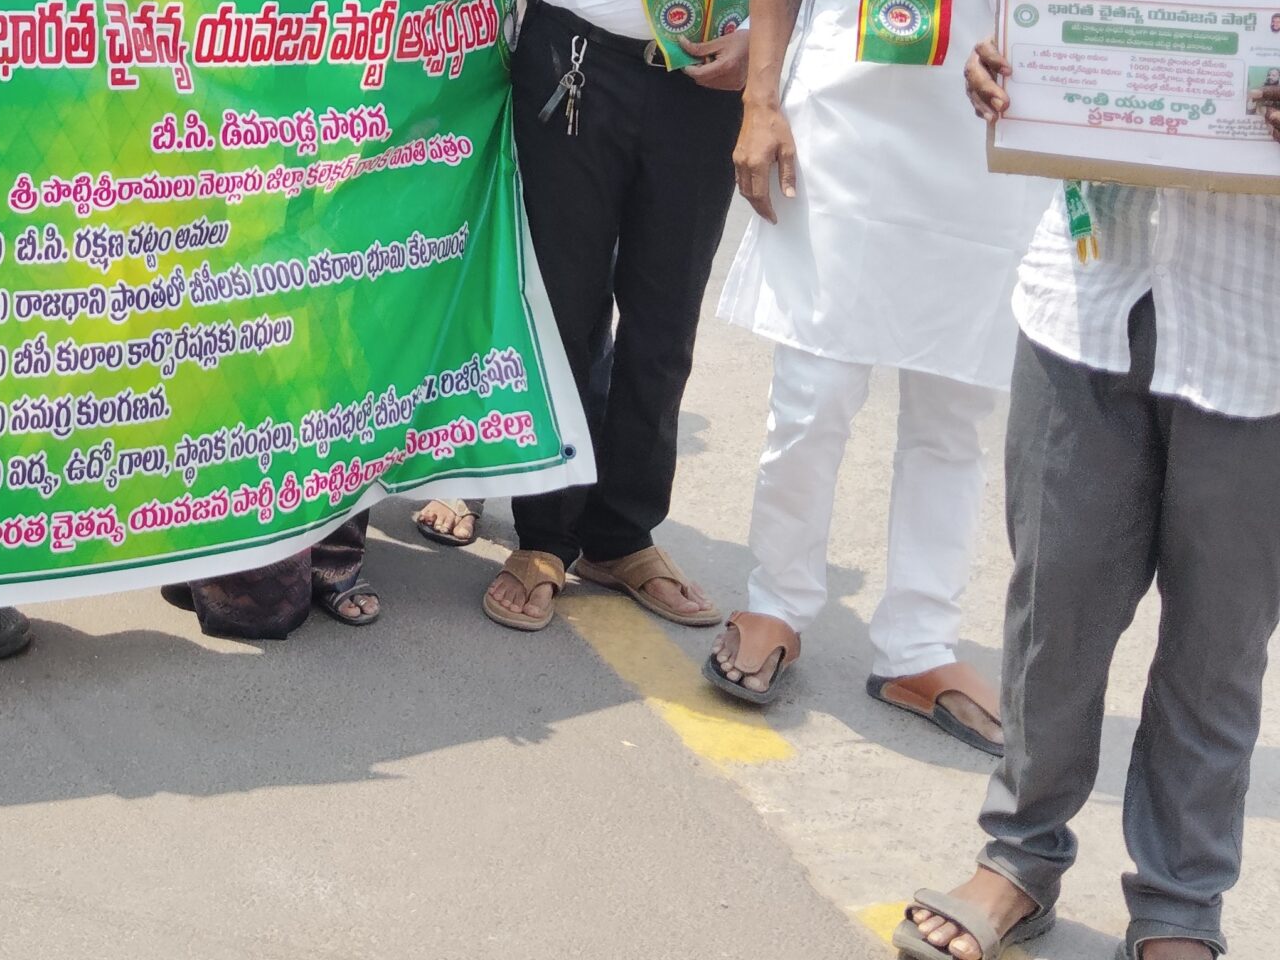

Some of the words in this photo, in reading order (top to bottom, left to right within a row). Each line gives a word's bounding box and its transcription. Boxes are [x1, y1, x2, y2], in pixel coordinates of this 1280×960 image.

[1048, 2, 1094, 17] భారత
[1098, 4, 1145, 25] చైతన్య
[1148, 7, 1217, 25] యువజన
[1221, 11, 1257, 31] పార్టీ
[104, 2, 192, 90] చైతన్య
[194, 3, 328, 64] యువజన
[329, 0, 398, 87] పార్టీ
[152, 113, 214, 150] బీ.సి.
[221, 110, 317, 153] డిమాండ్ల
[321, 105, 392, 142] సాధన,
[1063, 91, 1109, 107] శాంతి
[1115, 94, 1165, 111] యుత
[1171, 98, 1216, 120] ర్యాలీ
[1088, 108, 1144, 126] ప్రకాశం
[1149, 114, 1188, 135] జిల్లా
[10, 176, 38, 210] శ్రీ
[199, 168, 263, 202] నెల్లూరు
[266, 168, 305, 194] జిల్లా
[429, 134, 472, 163] పత్రం
[17, 226, 68, 262] బీ.సి.
[75, 229, 124, 270] రక్షణ
[128, 226, 171, 269] చట్టం
[174, 219, 229, 250] అమలు
[15, 289, 106, 321] రాజధాని
[189, 264, 252, 304] బీసీలకు
[253, 262, 305, 293] 1000
[308, 250, 364, 284] ఎకరాల
[366, 242, 405, 279] భూమి
[14, 336, 51, 376] బీసీ
[56, 341, 122, 373] కులాల
[239, 317, 293, 354] నిధులు
[9, 454, 59, 495] విద్య,
[66, 441, 170, 489] ఉద్యోగాలు,
[175, 430, 227, 485] స్థానిక
[230, 417, 297, 471] సంస్థలు,
[301, 392, 373, 455] చట్టసభల్లో
[11, 397, 72, 436] సమగ్ర
[52, 509, 124, 549] చైతన్య
[130, 492, 229, 531] యువజన
[233, 481, 273, 521] పార్టీ
[278, 473, 301, 510] శ్రీ
[480, 412, 535, 444] జిల్లా
